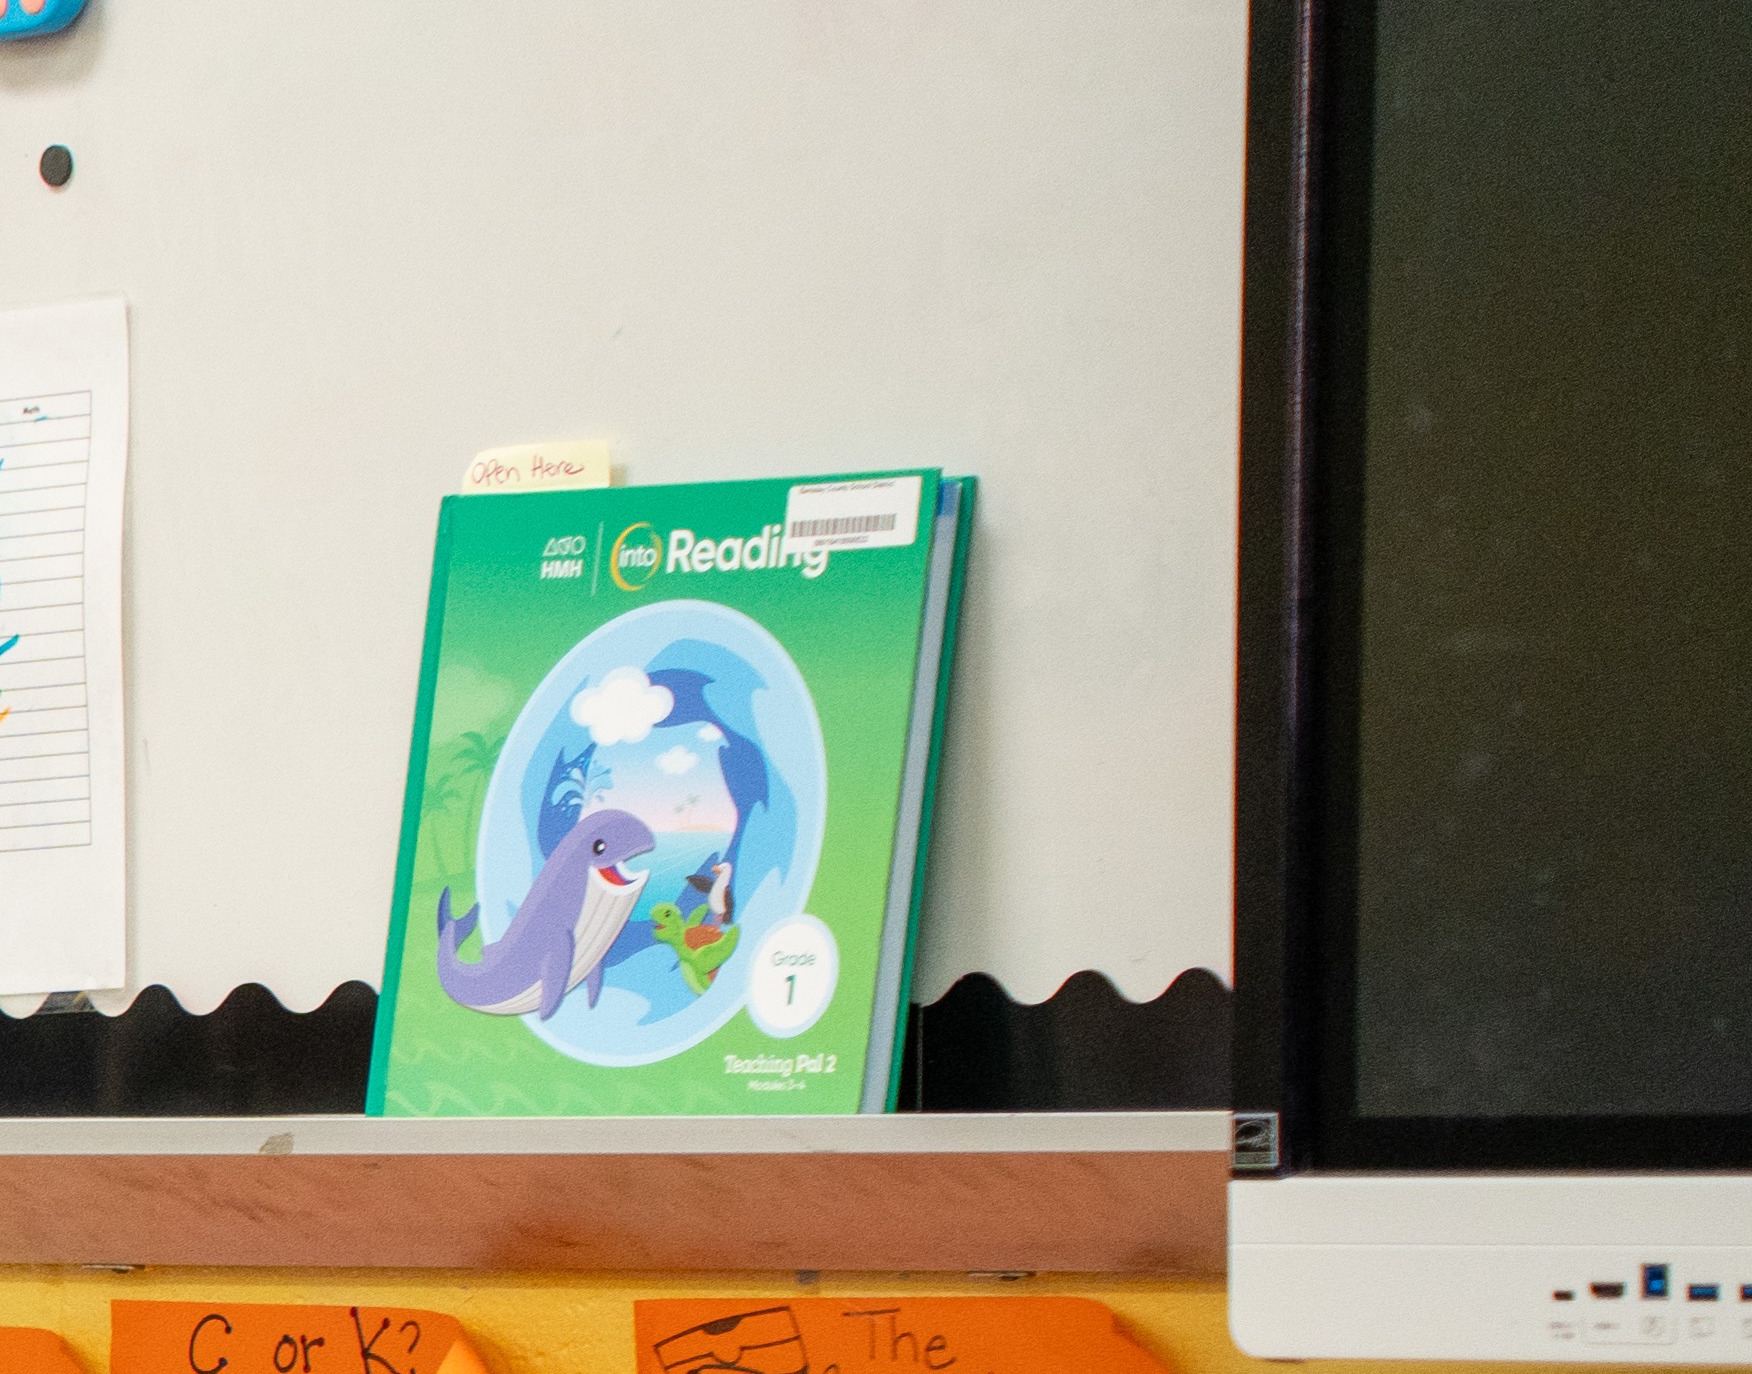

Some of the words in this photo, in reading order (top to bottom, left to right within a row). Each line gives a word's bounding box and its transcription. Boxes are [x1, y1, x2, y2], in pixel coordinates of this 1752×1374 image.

[531, 455, 584, 479] Here
[619, 544, 658, 568] into
[540, 559, 584, 579] HMH
[772, 950, 817, 967] Grade
[785, 974, 796, 1006] 1
[723, 1053, 794, 1078] Teaching
[795, 1052, 824, 1073] Pal
[825, 1054, 838, 1073] 2
[842, 1308, 958, 1371] The
[273, 1333, 325, 1374] or
